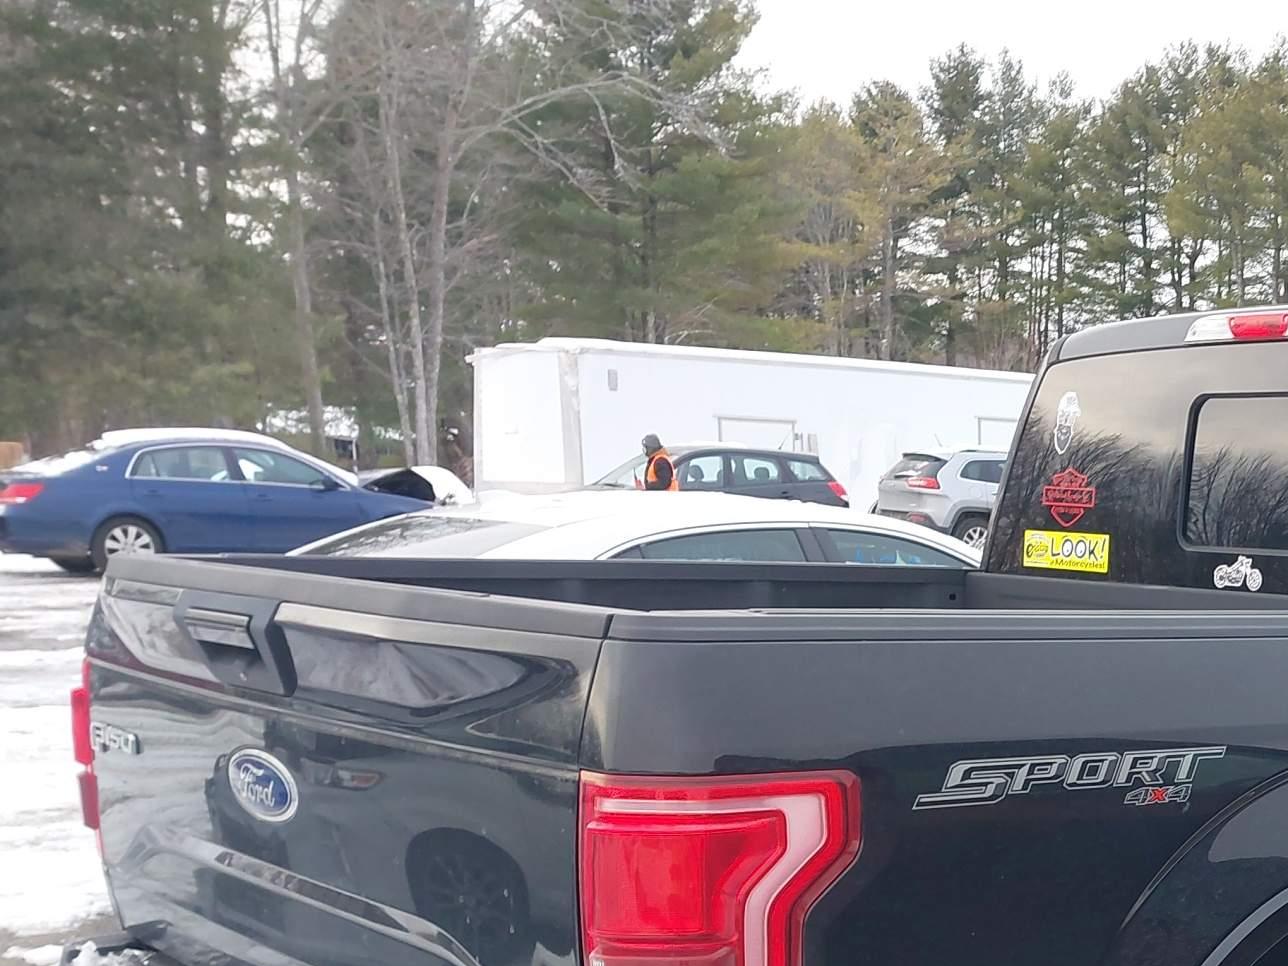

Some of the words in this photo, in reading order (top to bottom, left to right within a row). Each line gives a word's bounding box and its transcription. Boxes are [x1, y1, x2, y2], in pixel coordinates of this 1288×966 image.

[1051, 536, 1106, 561] LOOK!
[240, 762, 275, 807] Ford
[912, 745, 1227, 810] SPORT
